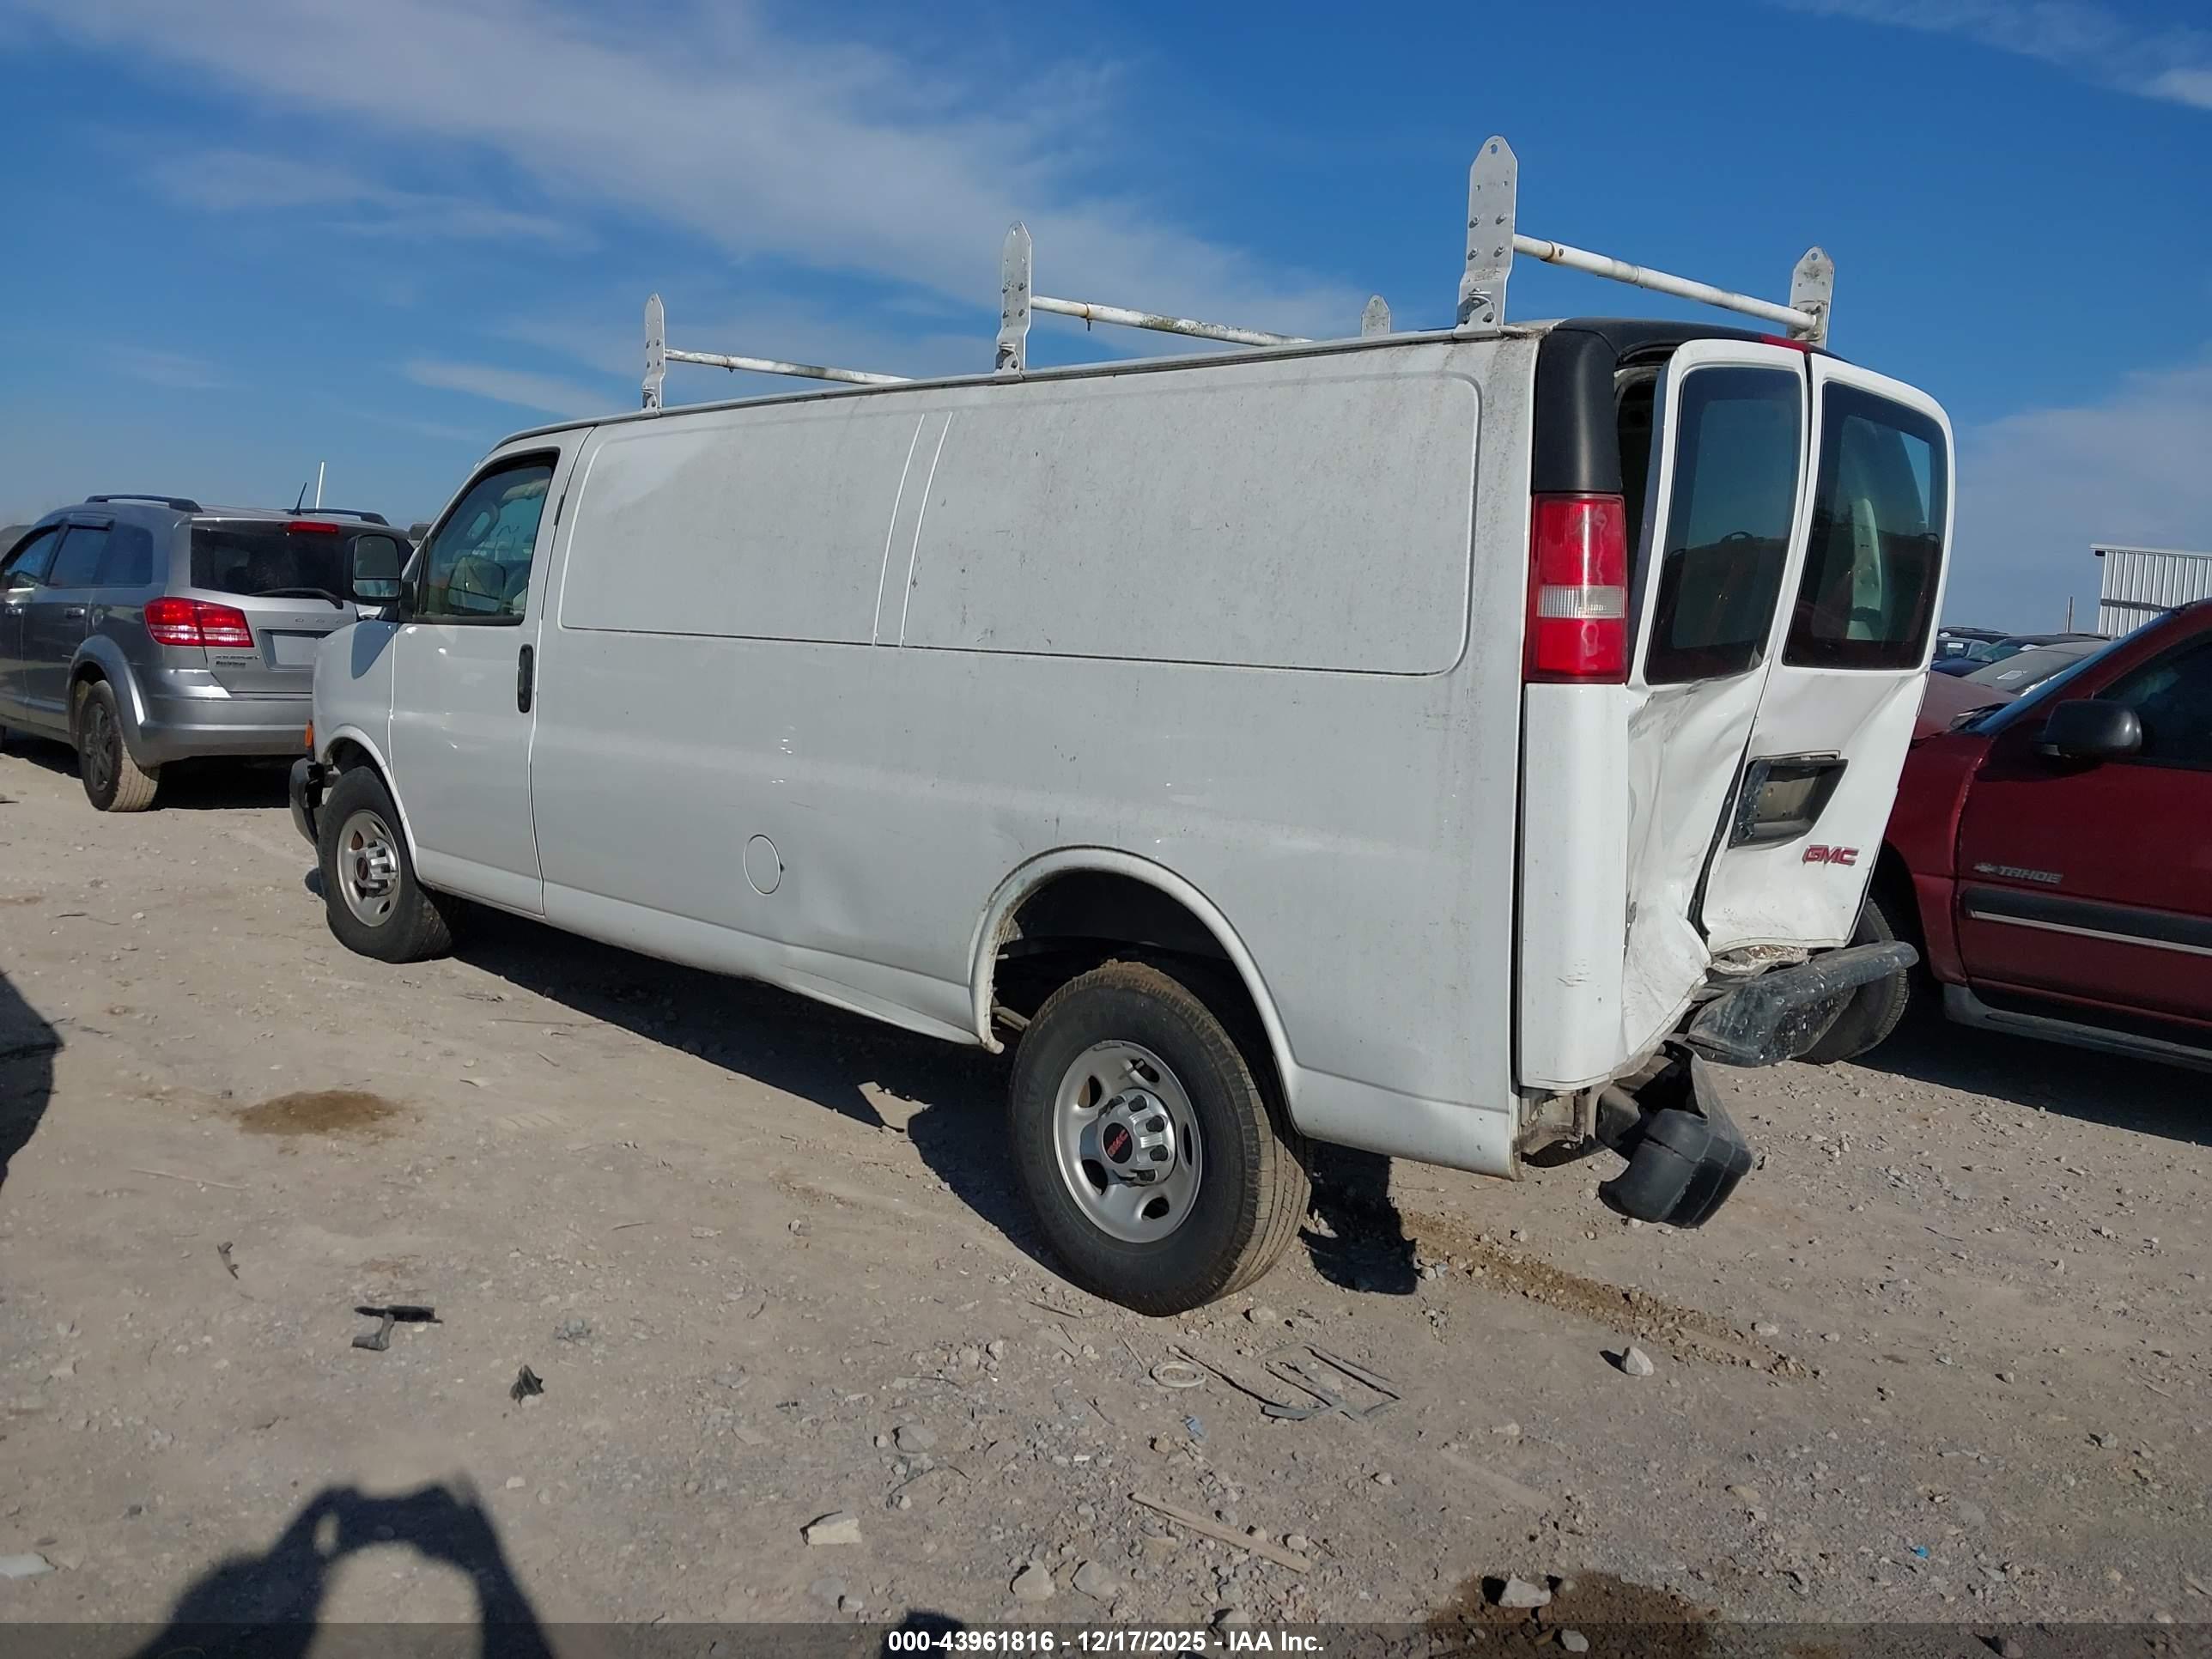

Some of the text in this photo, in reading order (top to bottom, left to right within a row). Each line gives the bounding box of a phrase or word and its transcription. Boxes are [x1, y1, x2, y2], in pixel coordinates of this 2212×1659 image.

[1802, 845, 1859, 866] GMC
[1999, 866, 2063, 884] TAHOE
[1107, 1129, 1128, 1157] GMC
